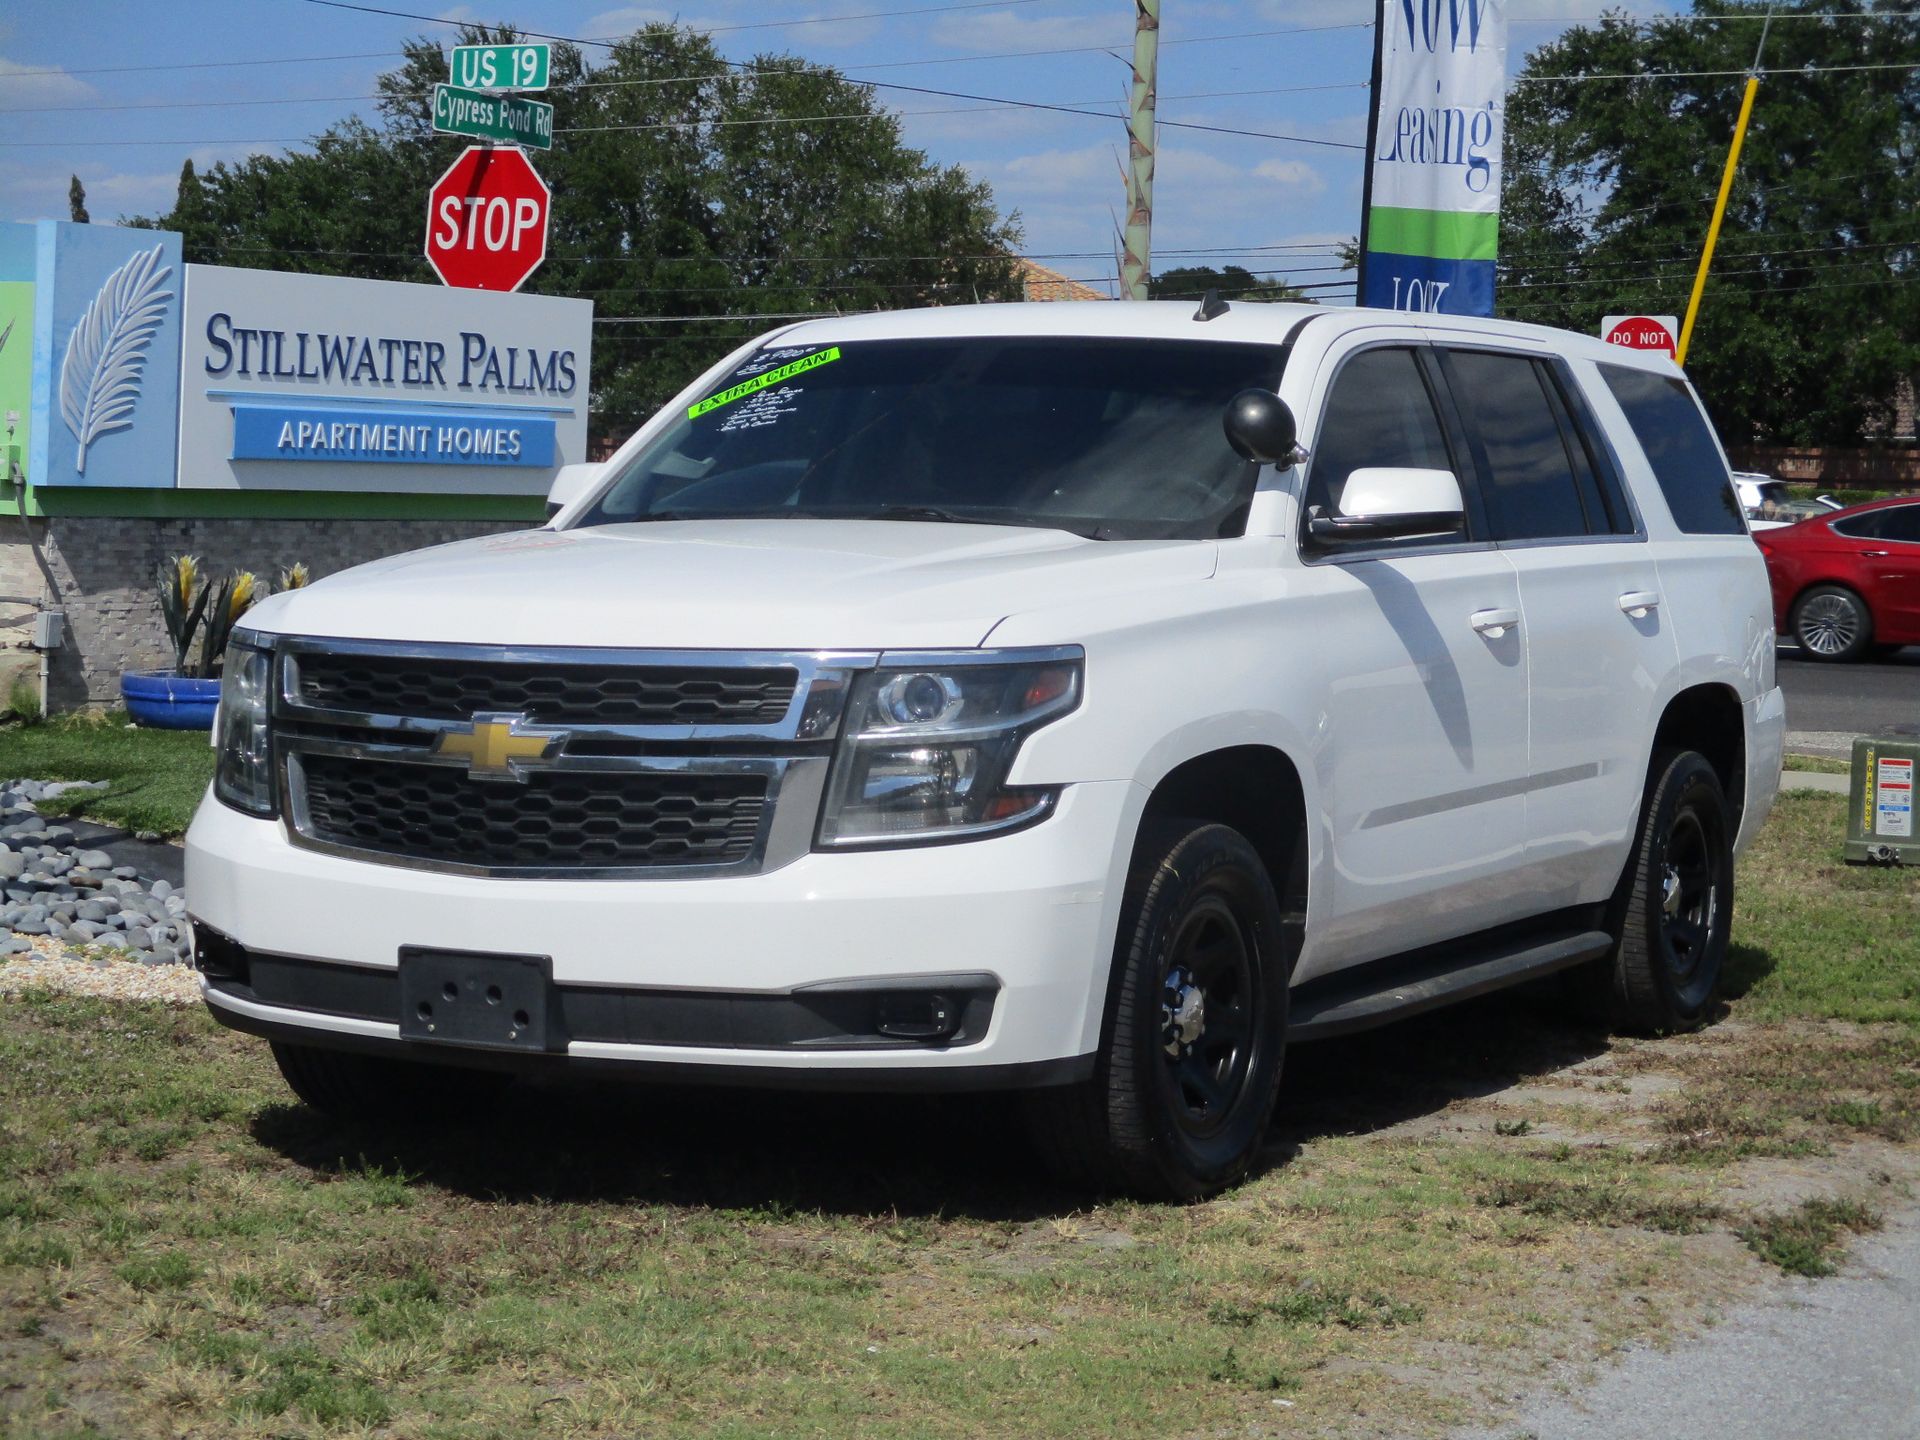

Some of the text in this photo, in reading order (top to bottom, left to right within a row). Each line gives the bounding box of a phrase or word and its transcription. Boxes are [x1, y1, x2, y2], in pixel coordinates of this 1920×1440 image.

[462, 48, 538, 87] US 19
[437, 88, 552, 137] Cypress Pond Rd
[435, 195, 540, 252] STOP
[205, 312, 577, 394] STILLWATER PALMS
[1613, 332, 1666, 345] DO NOT
[697, 377, 761, 413] EXTRA
[765, 350, 831, 383] CLEAN
[277, 421, 521, 456] APARTMENT HOMES
